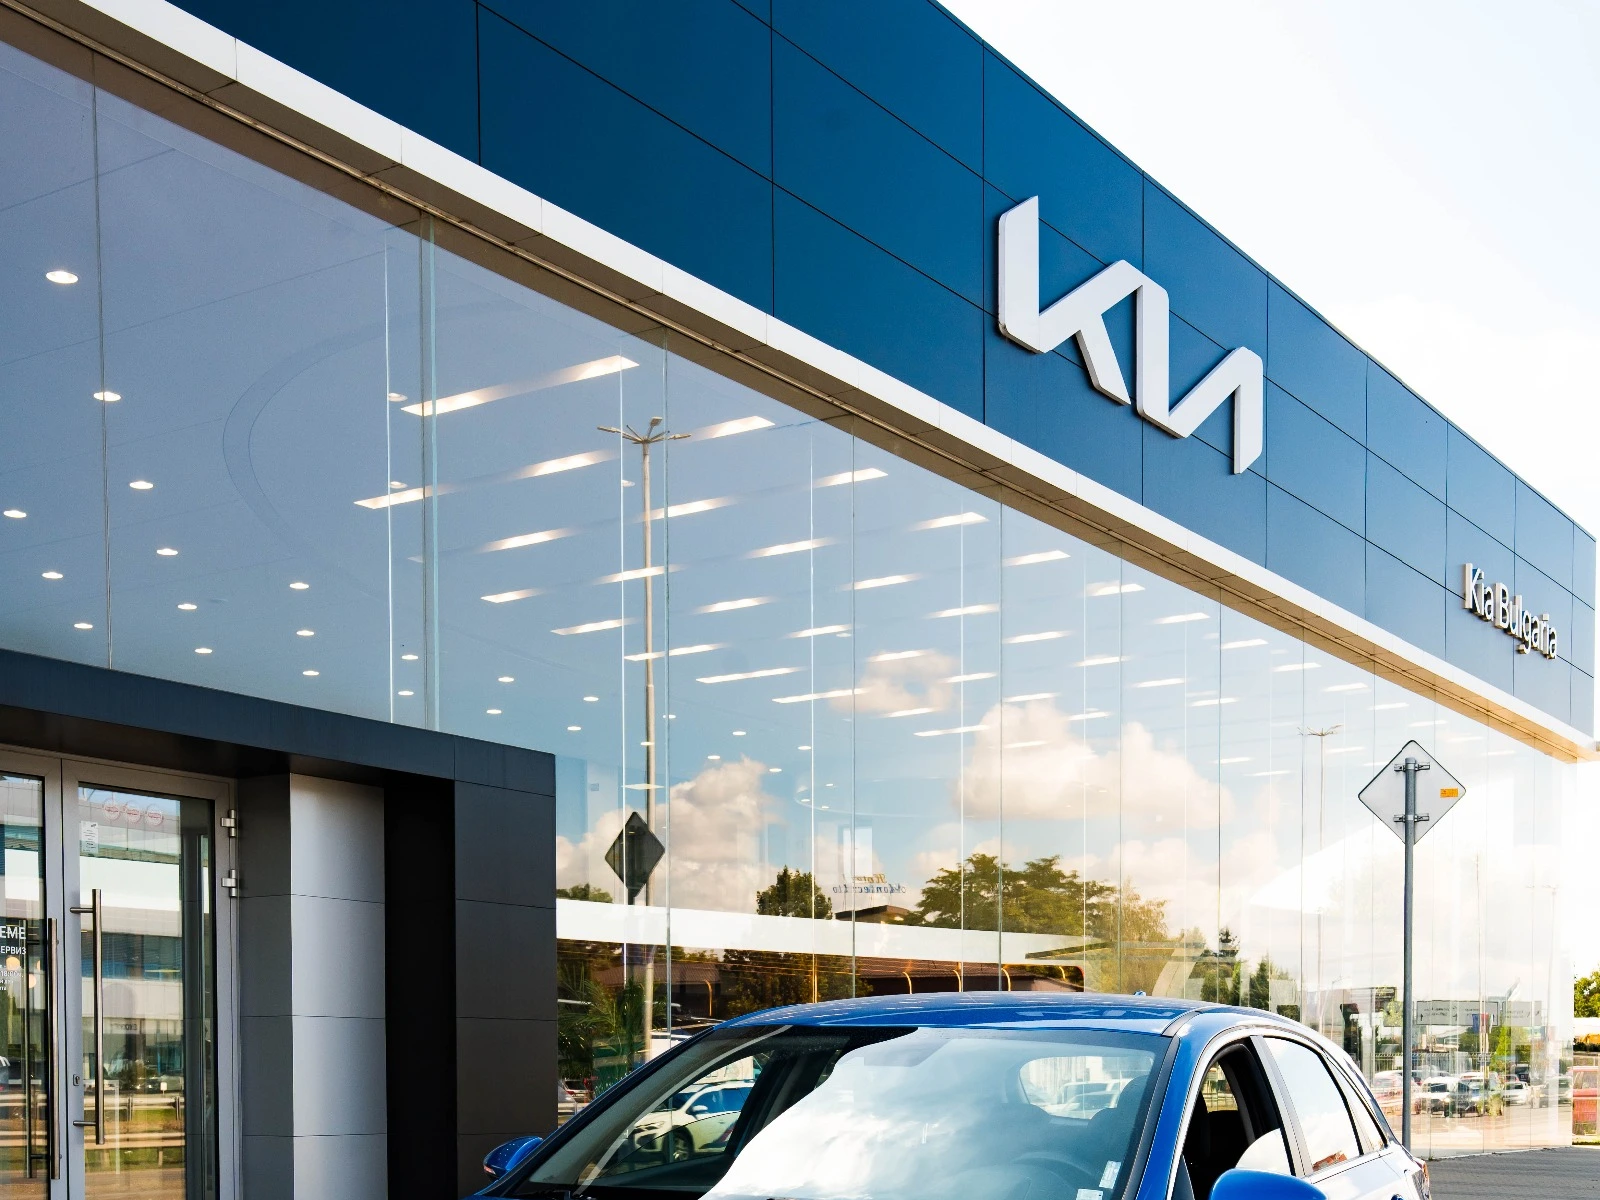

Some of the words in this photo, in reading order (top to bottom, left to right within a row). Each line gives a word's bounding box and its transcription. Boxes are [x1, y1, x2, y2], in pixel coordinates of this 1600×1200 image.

[998, 195, 1263, 475] KIA
[1464, 562, 1495, 621] Kia
[1494, 582, 1557, 660] Bulgaria
